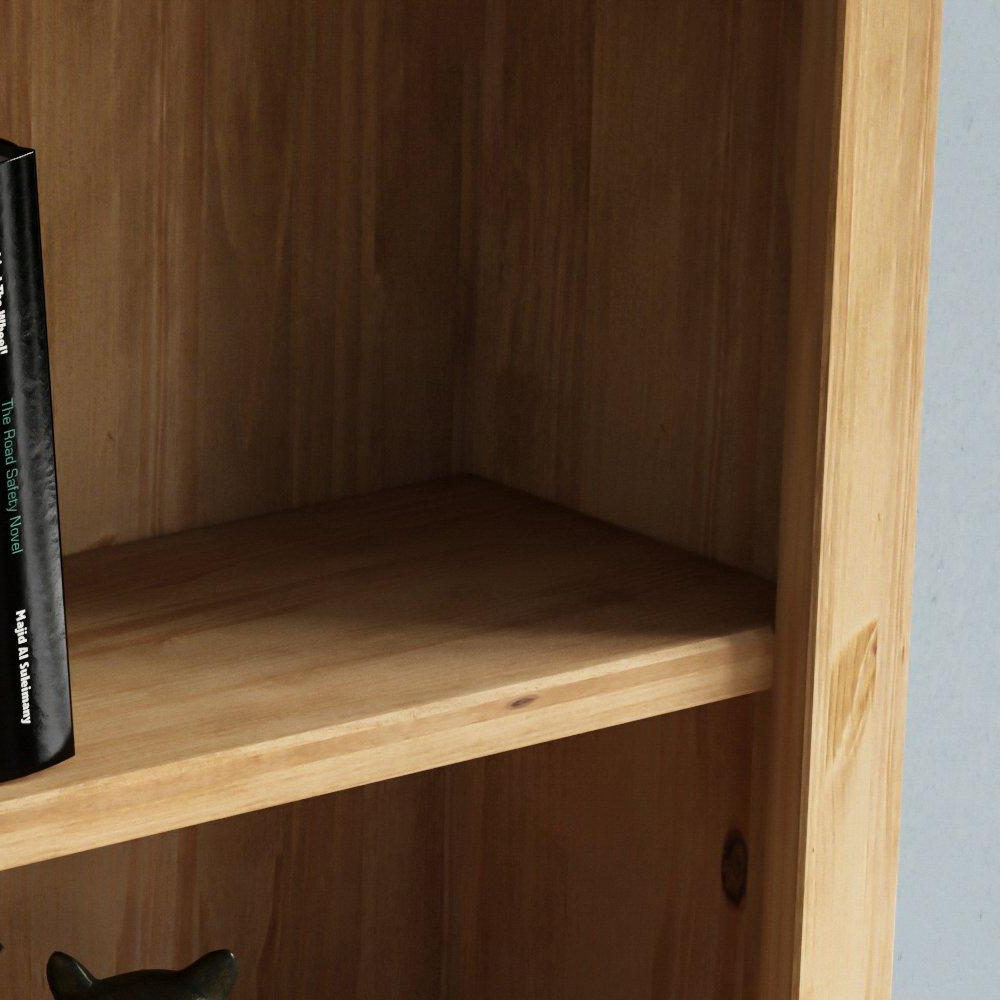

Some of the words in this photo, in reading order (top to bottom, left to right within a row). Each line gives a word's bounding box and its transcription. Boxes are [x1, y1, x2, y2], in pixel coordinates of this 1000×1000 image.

[1, 398, 15, 425] The
[3, 428, 17, 466] Road
[6, 468, 20, 512] Safety
[10, 515, 24, 555] Novel
[14, 609, 28, 645] Majid
[18, 646, 29, 660] Al
[19, 661, 32, 724] Suleimany
